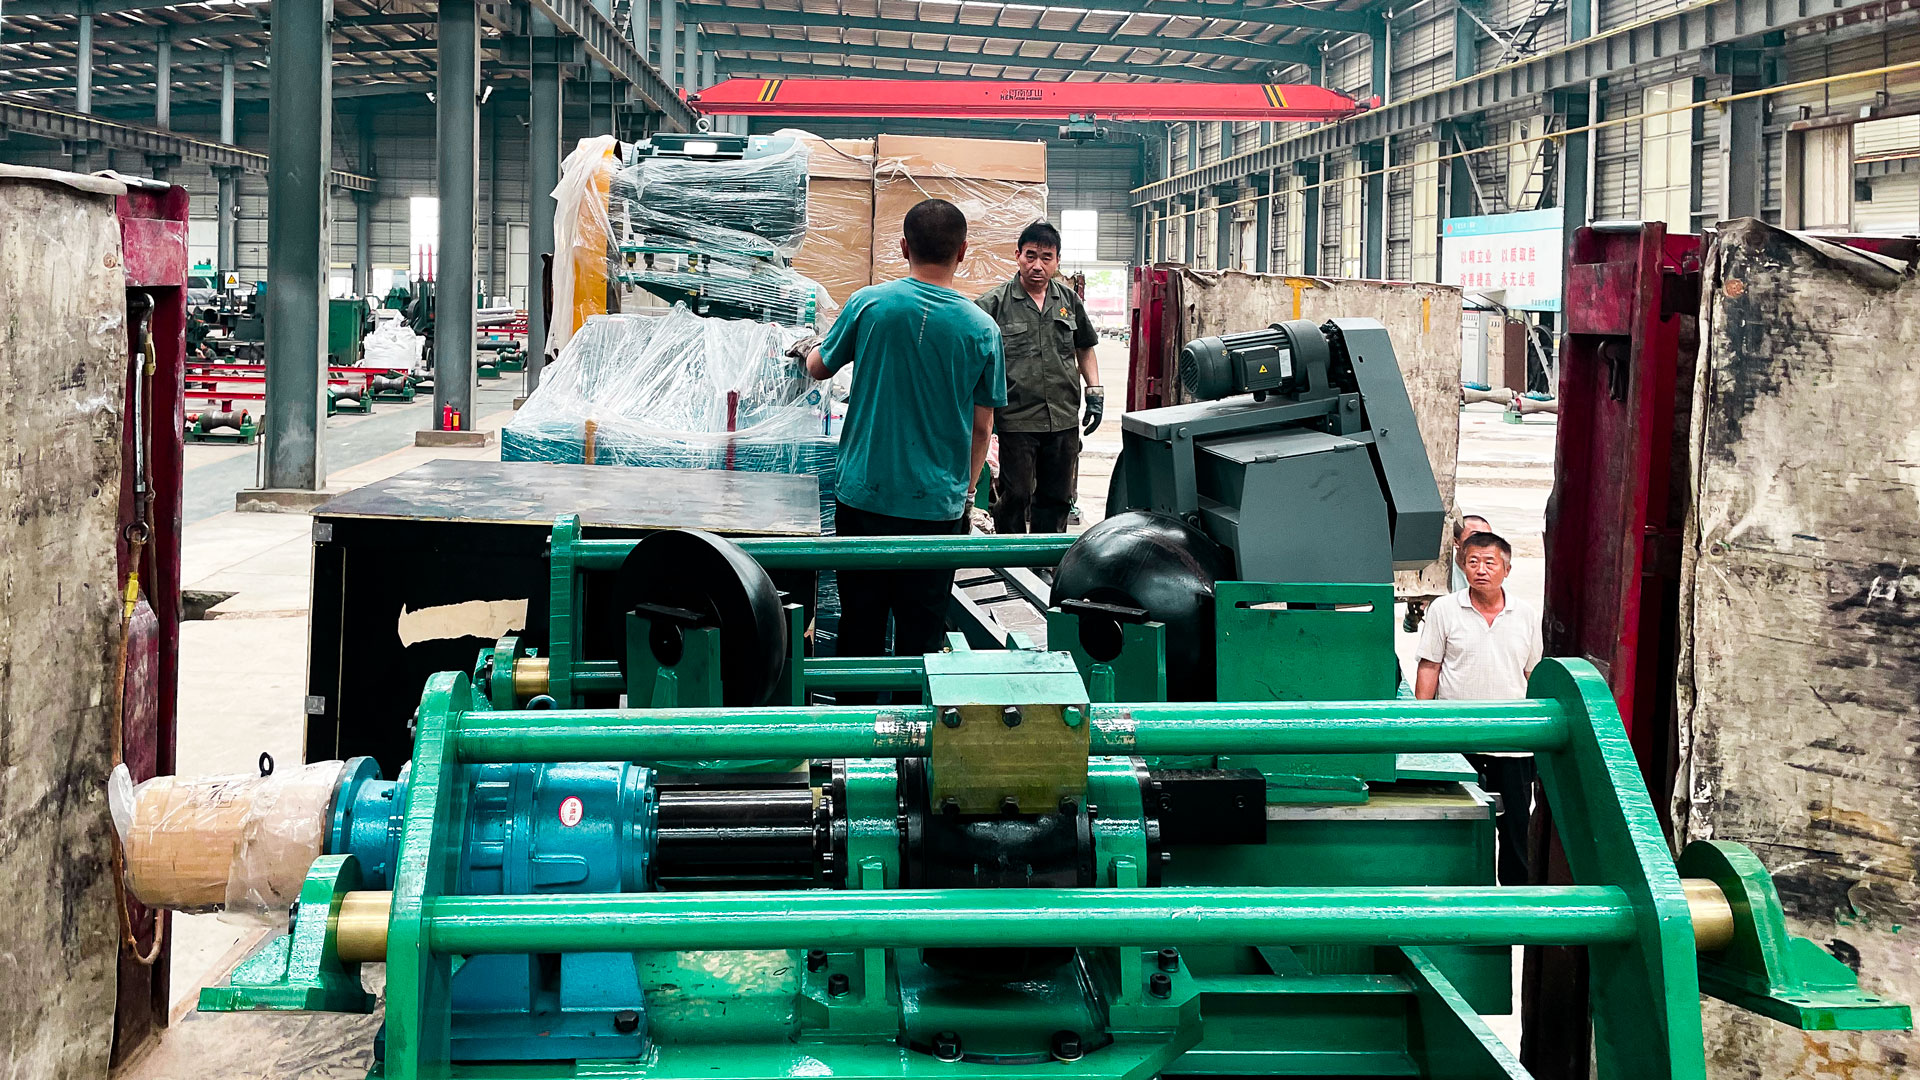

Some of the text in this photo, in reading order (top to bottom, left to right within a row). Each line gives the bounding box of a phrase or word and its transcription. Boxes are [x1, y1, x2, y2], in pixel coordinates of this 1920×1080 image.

[1460, 271, 1536, 287] 改善提高 永无止境
